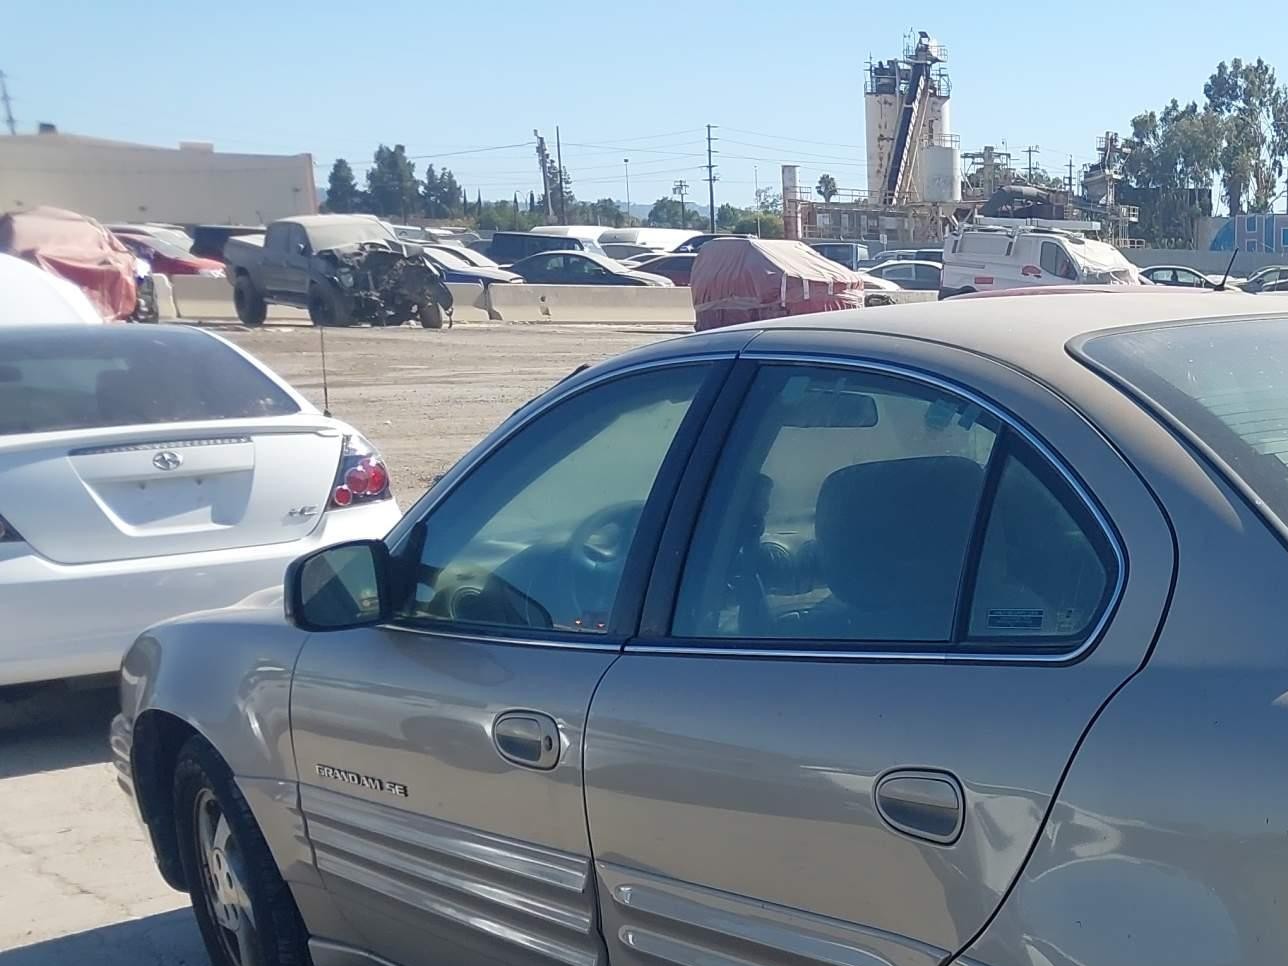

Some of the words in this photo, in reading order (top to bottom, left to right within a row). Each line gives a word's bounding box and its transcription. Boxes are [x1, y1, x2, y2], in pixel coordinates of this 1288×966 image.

[316, 764, 359, 785] GRAND
[360, 775, 383, 792] AM
[386, 781, 409, 798] SE
